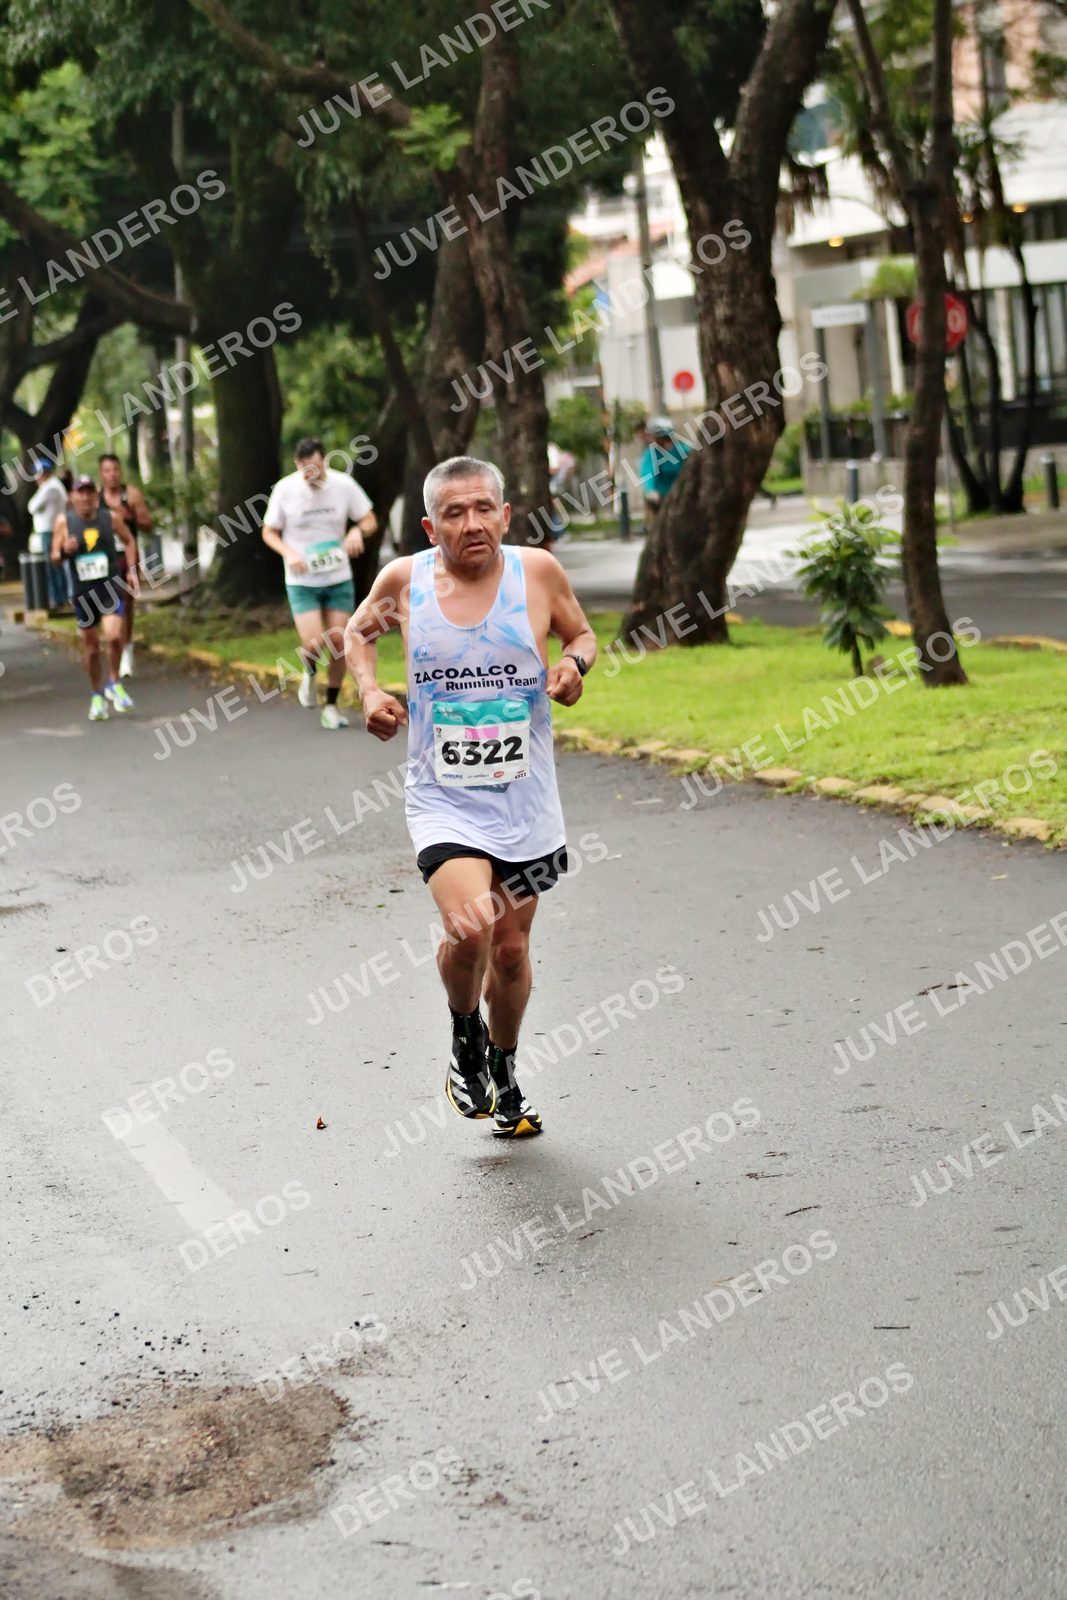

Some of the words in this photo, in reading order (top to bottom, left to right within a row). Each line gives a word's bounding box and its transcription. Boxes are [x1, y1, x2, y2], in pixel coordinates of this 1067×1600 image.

[414, 664, 517, 684] ZACOALCO
[445, 678, 504, 691] Running
[507, 676, 538, 687] Team
[441, 736, 524, 766] 6322
